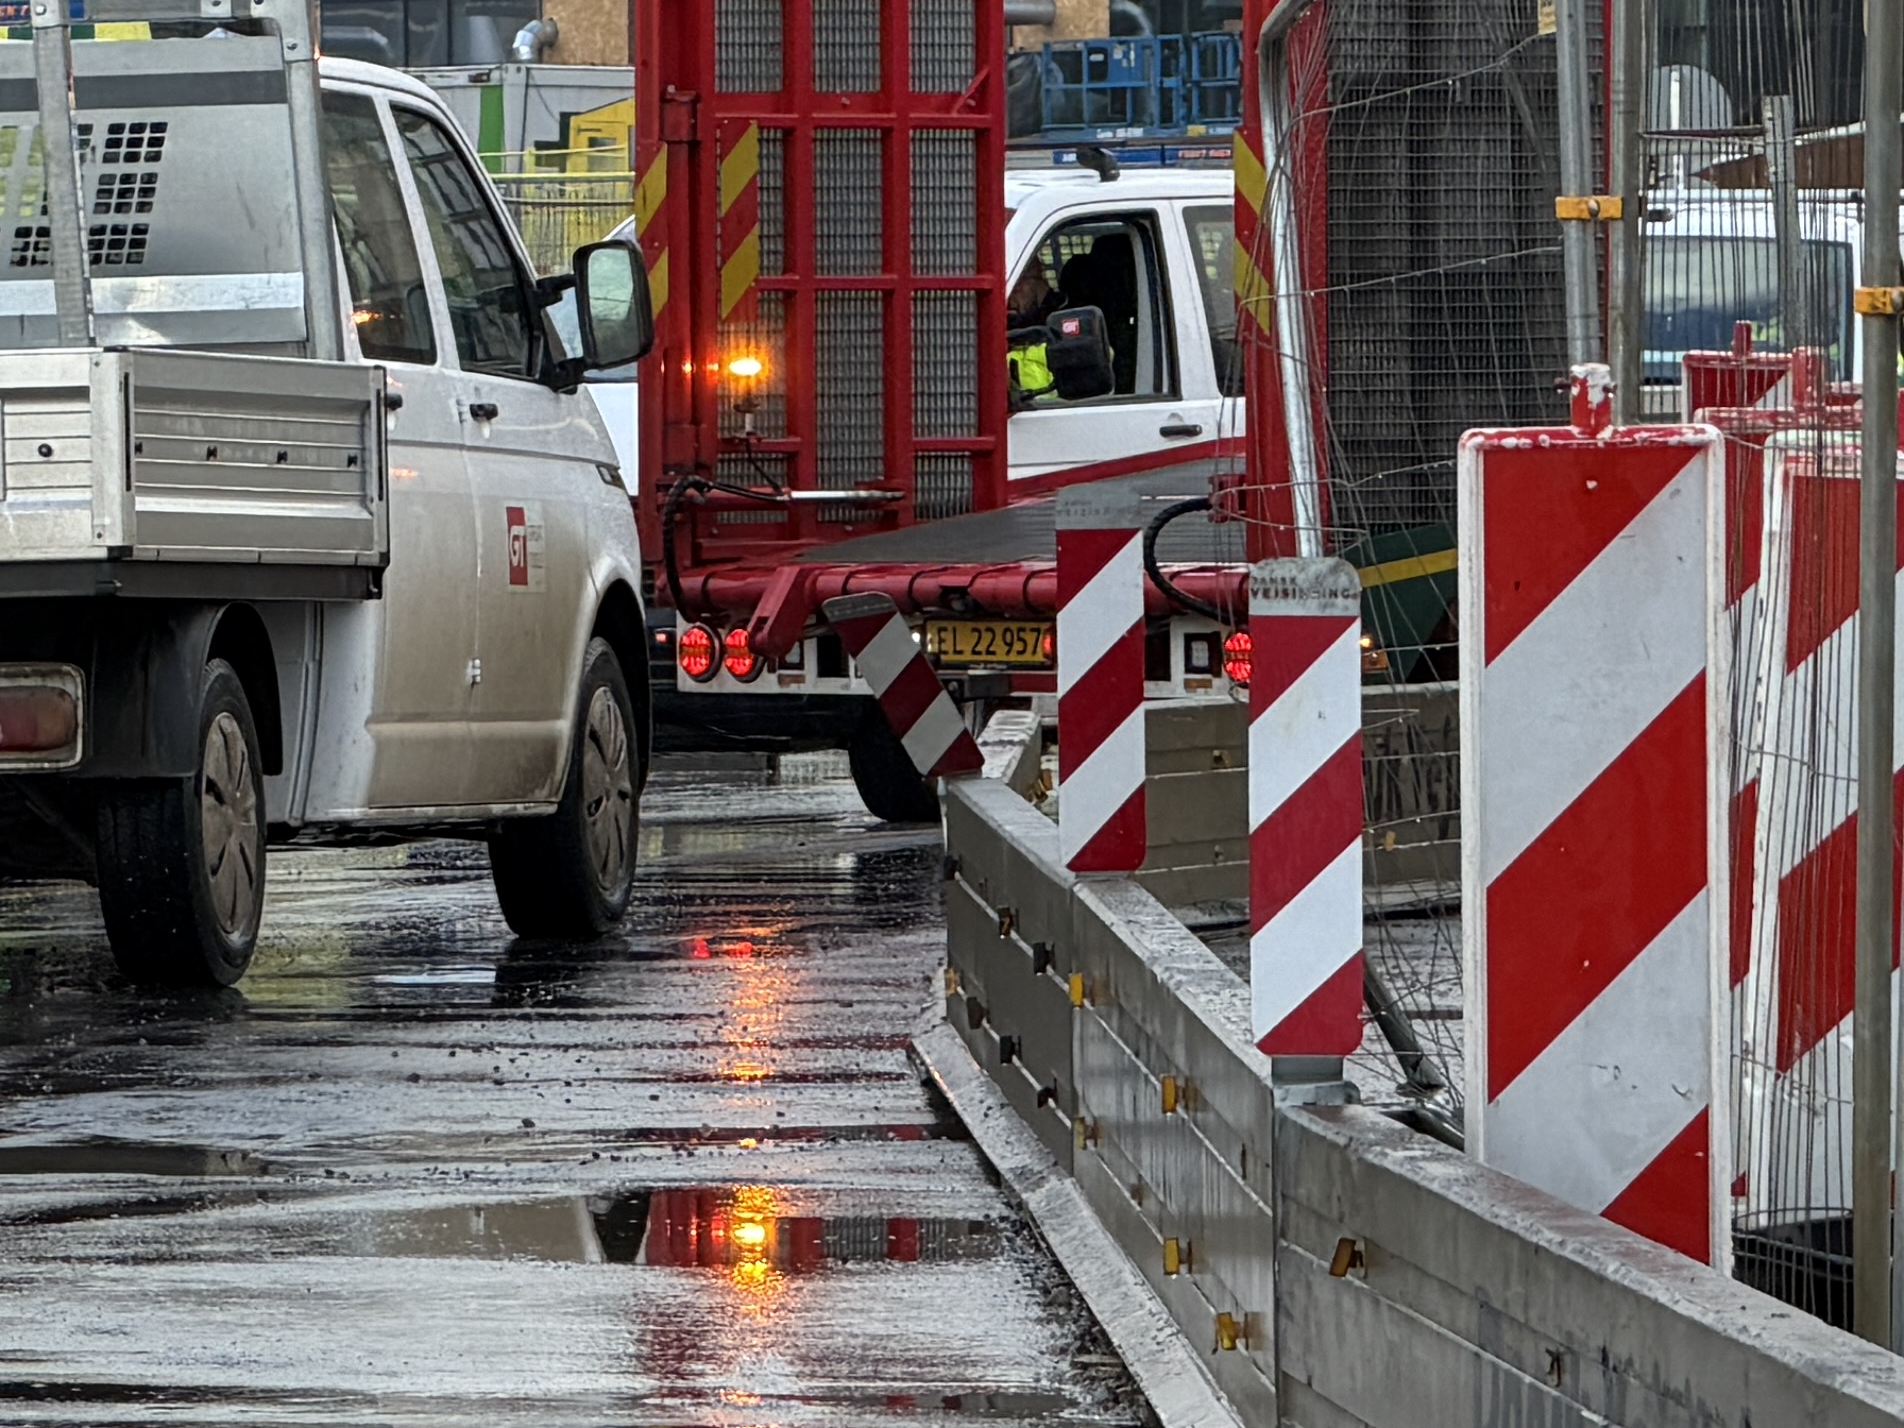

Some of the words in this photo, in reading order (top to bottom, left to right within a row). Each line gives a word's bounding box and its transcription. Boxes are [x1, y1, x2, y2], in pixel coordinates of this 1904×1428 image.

[937, 626, 964, 655] EL
[971, 627, 996, 655] 22
[1002, 626, 1041, 656] 957
